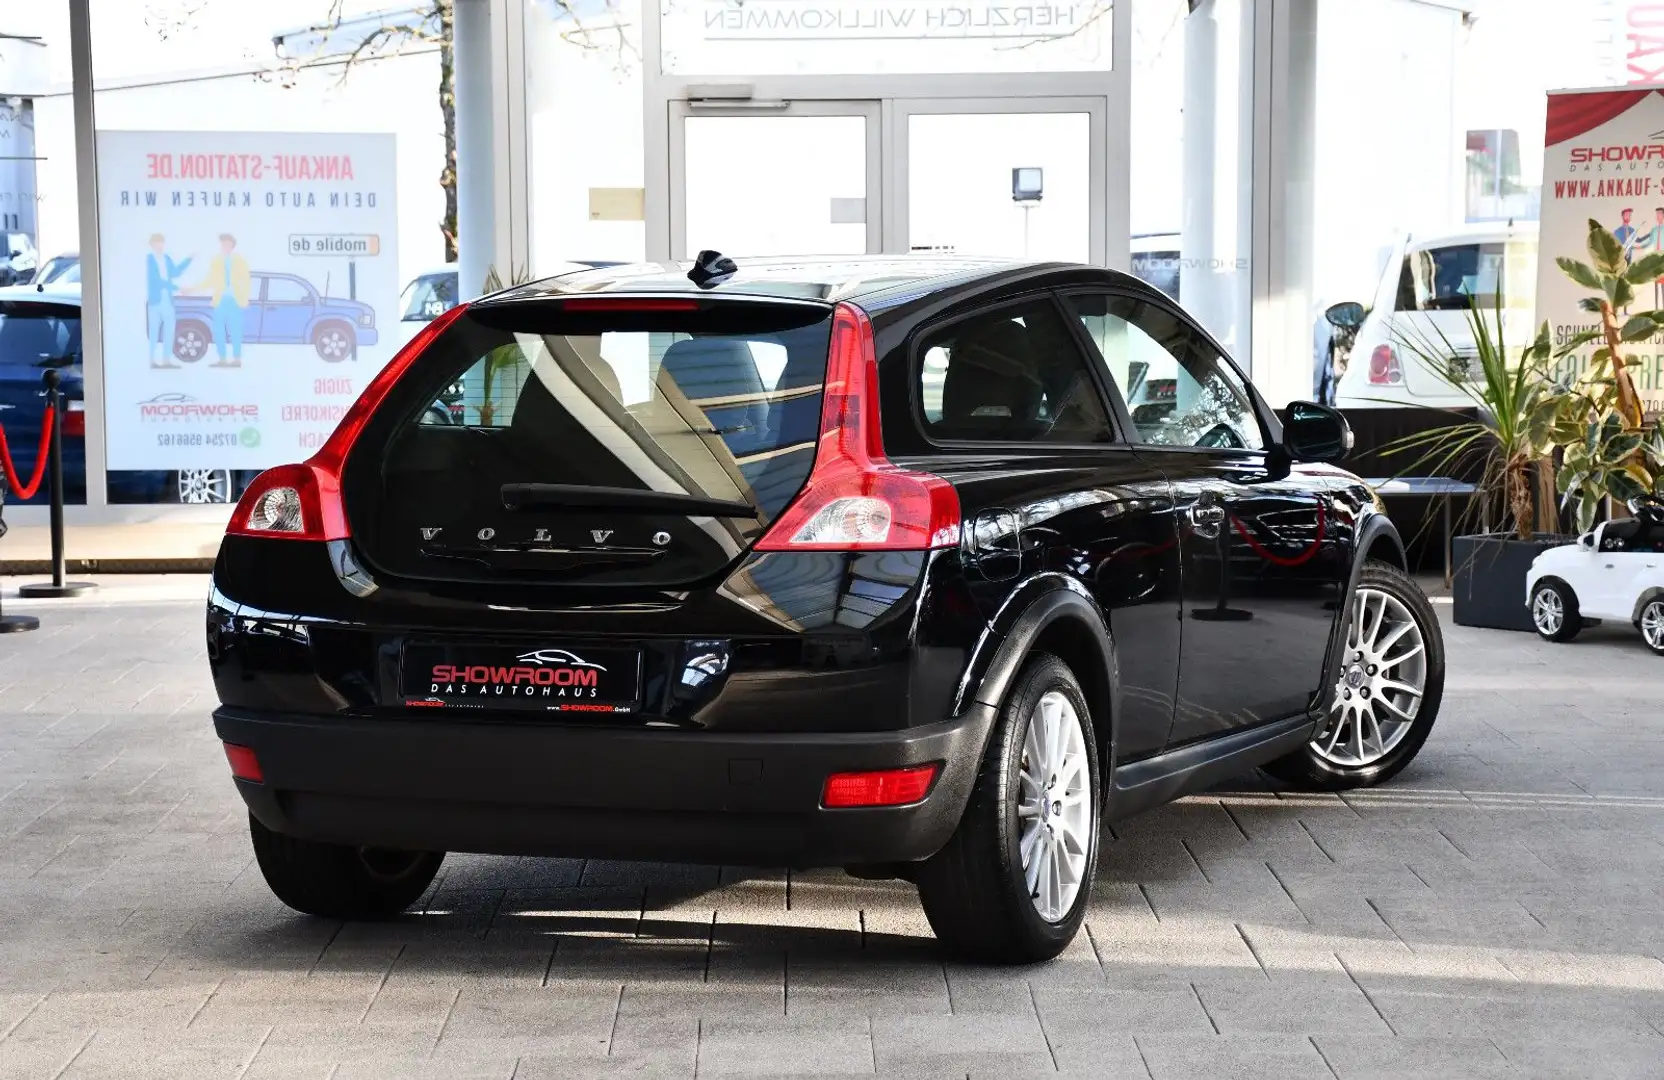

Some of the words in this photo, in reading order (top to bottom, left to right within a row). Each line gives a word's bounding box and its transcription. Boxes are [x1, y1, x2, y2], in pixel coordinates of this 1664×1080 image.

[1569, 164, 1605, 173] DAS
[420, 527, 672, 546] VOLVO
[432, 665, 598, 687] SHOWROOM
[431, 684, 467, 694] DAS
[480, 685, 597, 697] AUTOHAUS
